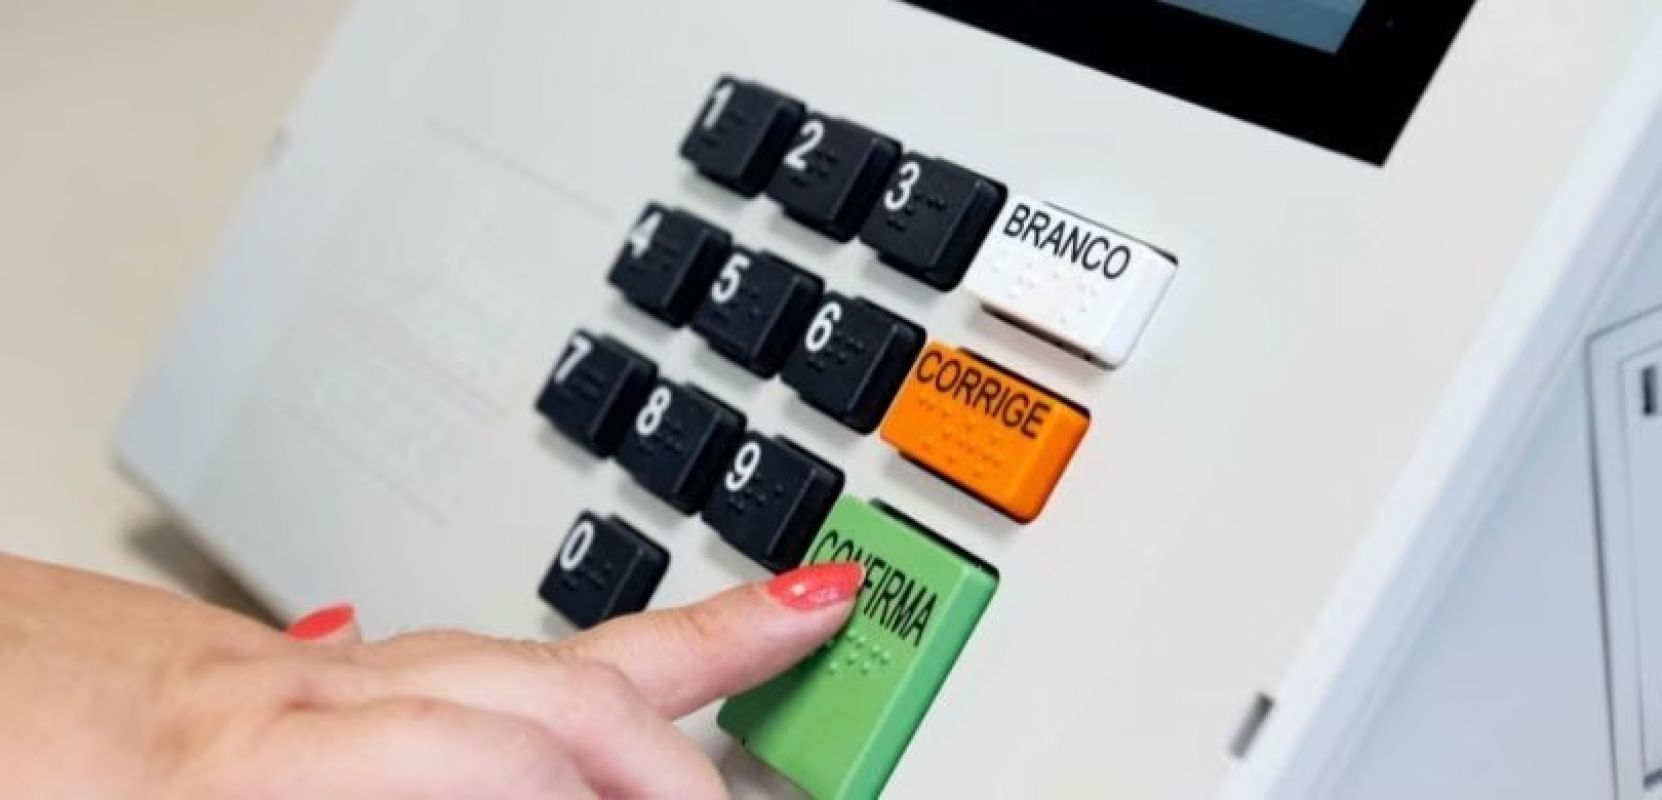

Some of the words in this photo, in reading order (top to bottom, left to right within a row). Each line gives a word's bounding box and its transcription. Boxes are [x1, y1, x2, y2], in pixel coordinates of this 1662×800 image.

[702, 83, 735, 129] 1
[784, 119, 825, 171] 2
[883, 160, 921, 211] 3
[628, 212, 663, 259] 4
[1003, 203, 1131, 280] BRANCO
[711, 253, 751, 304] 5
[805, 301, 842, 352] 6
[553, 335, 592, 385] 7
[635, 386, 672, 436] 8
[915, 349, 1052, 441] CORRIGE
[725, 441, 762, 492] 9
[558, 523, 595, 571] 0
[809, 530, 938, 649] CFIRMA
